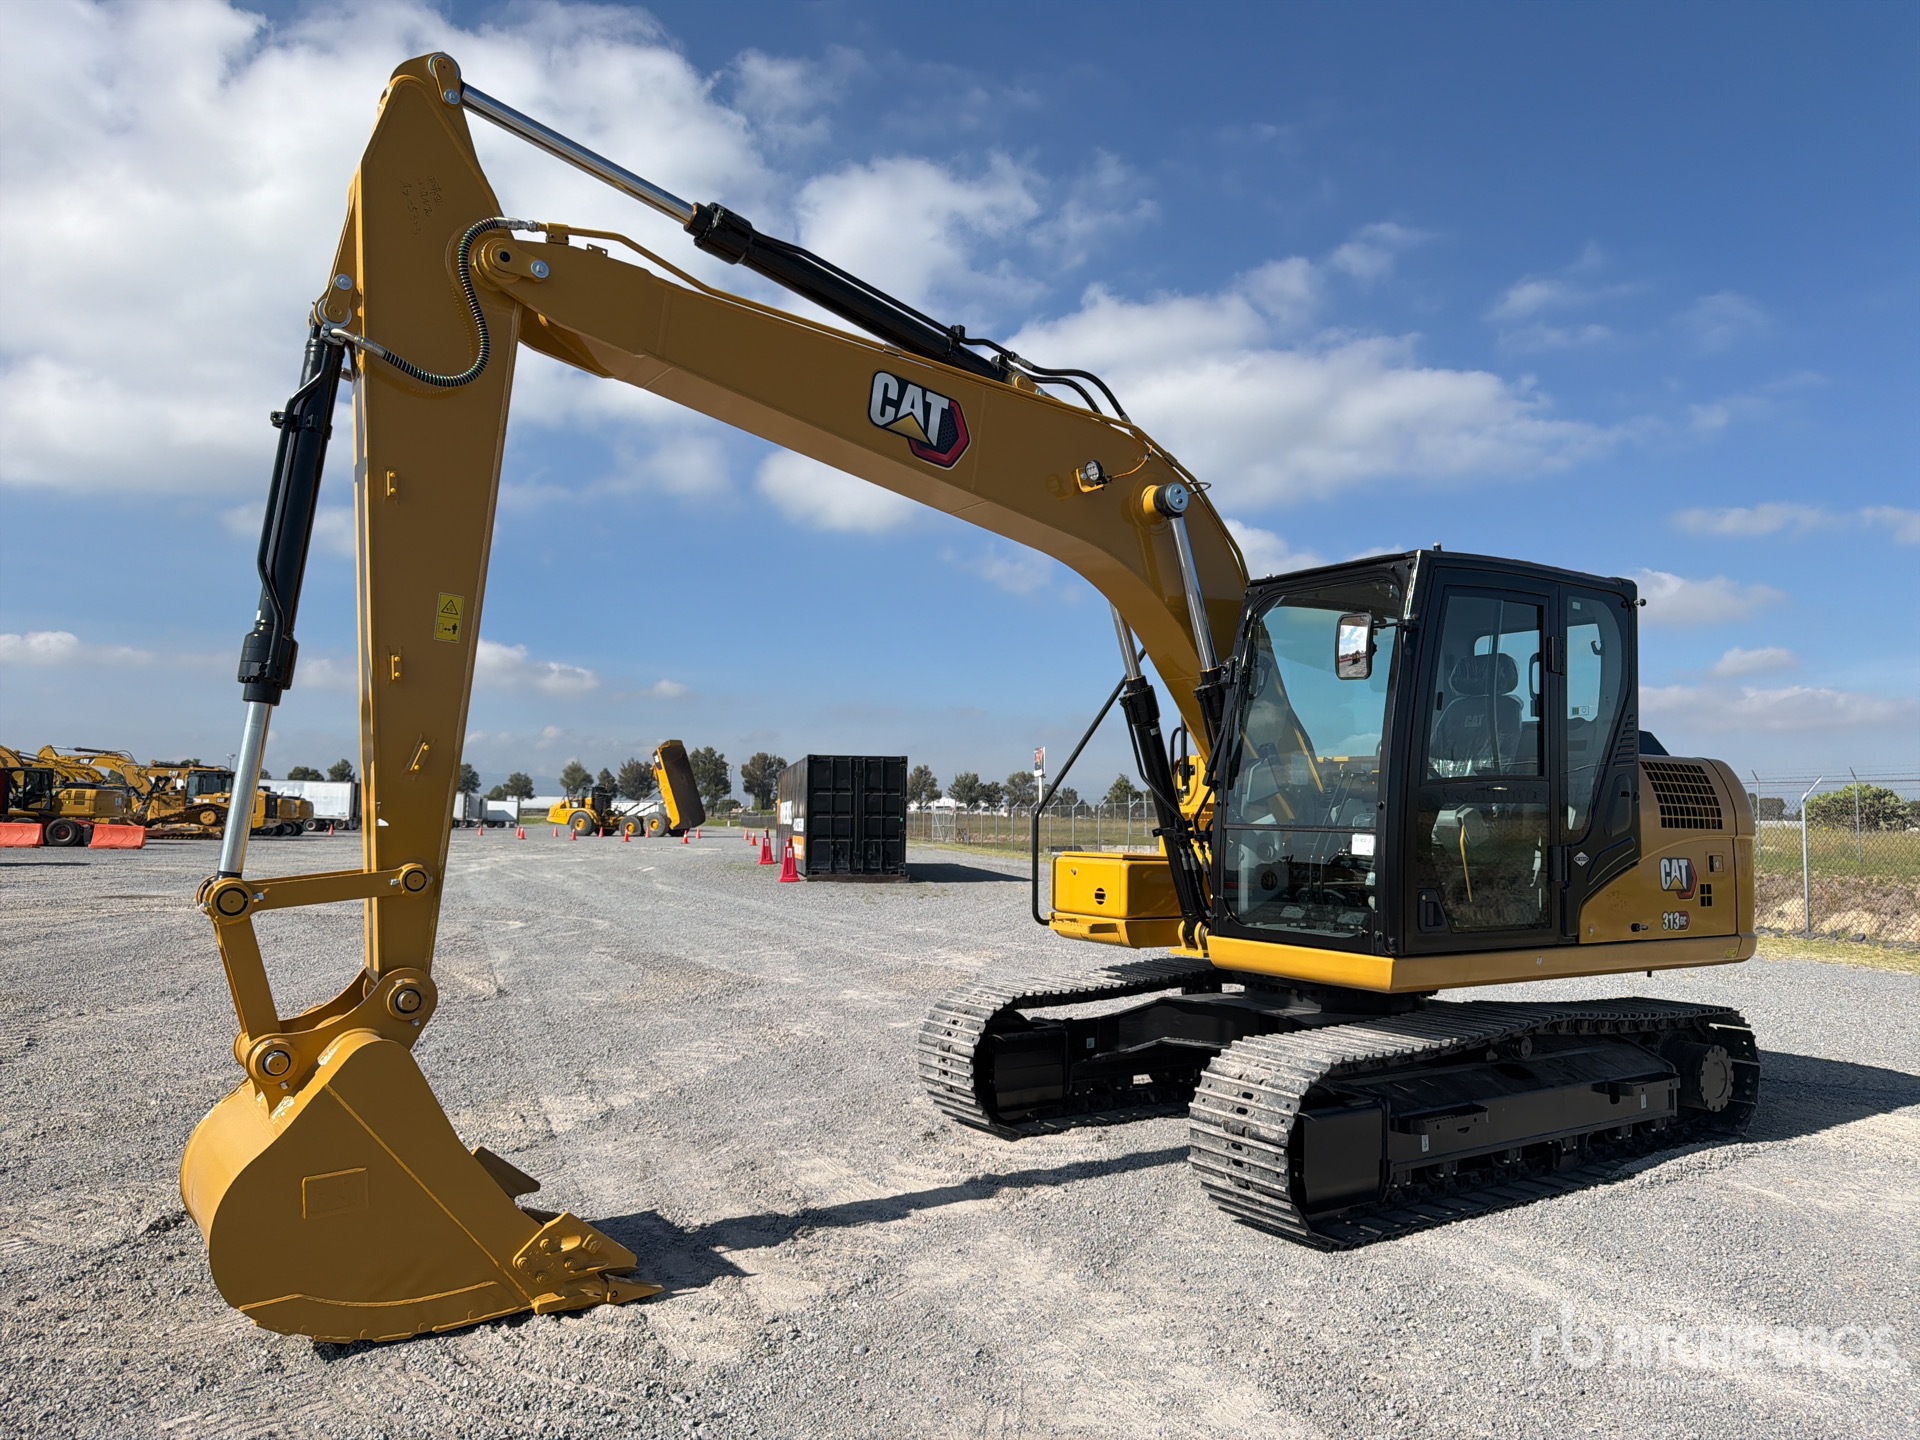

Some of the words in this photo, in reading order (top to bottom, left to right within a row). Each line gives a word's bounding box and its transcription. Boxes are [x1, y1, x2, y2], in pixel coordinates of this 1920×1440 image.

[870, 372, 950, 447] CAT
[1463, 714, 1484, 727] CAT
[1660, 858, 1688, 890] CAT
[1662, 912, 1680, 930] 313
